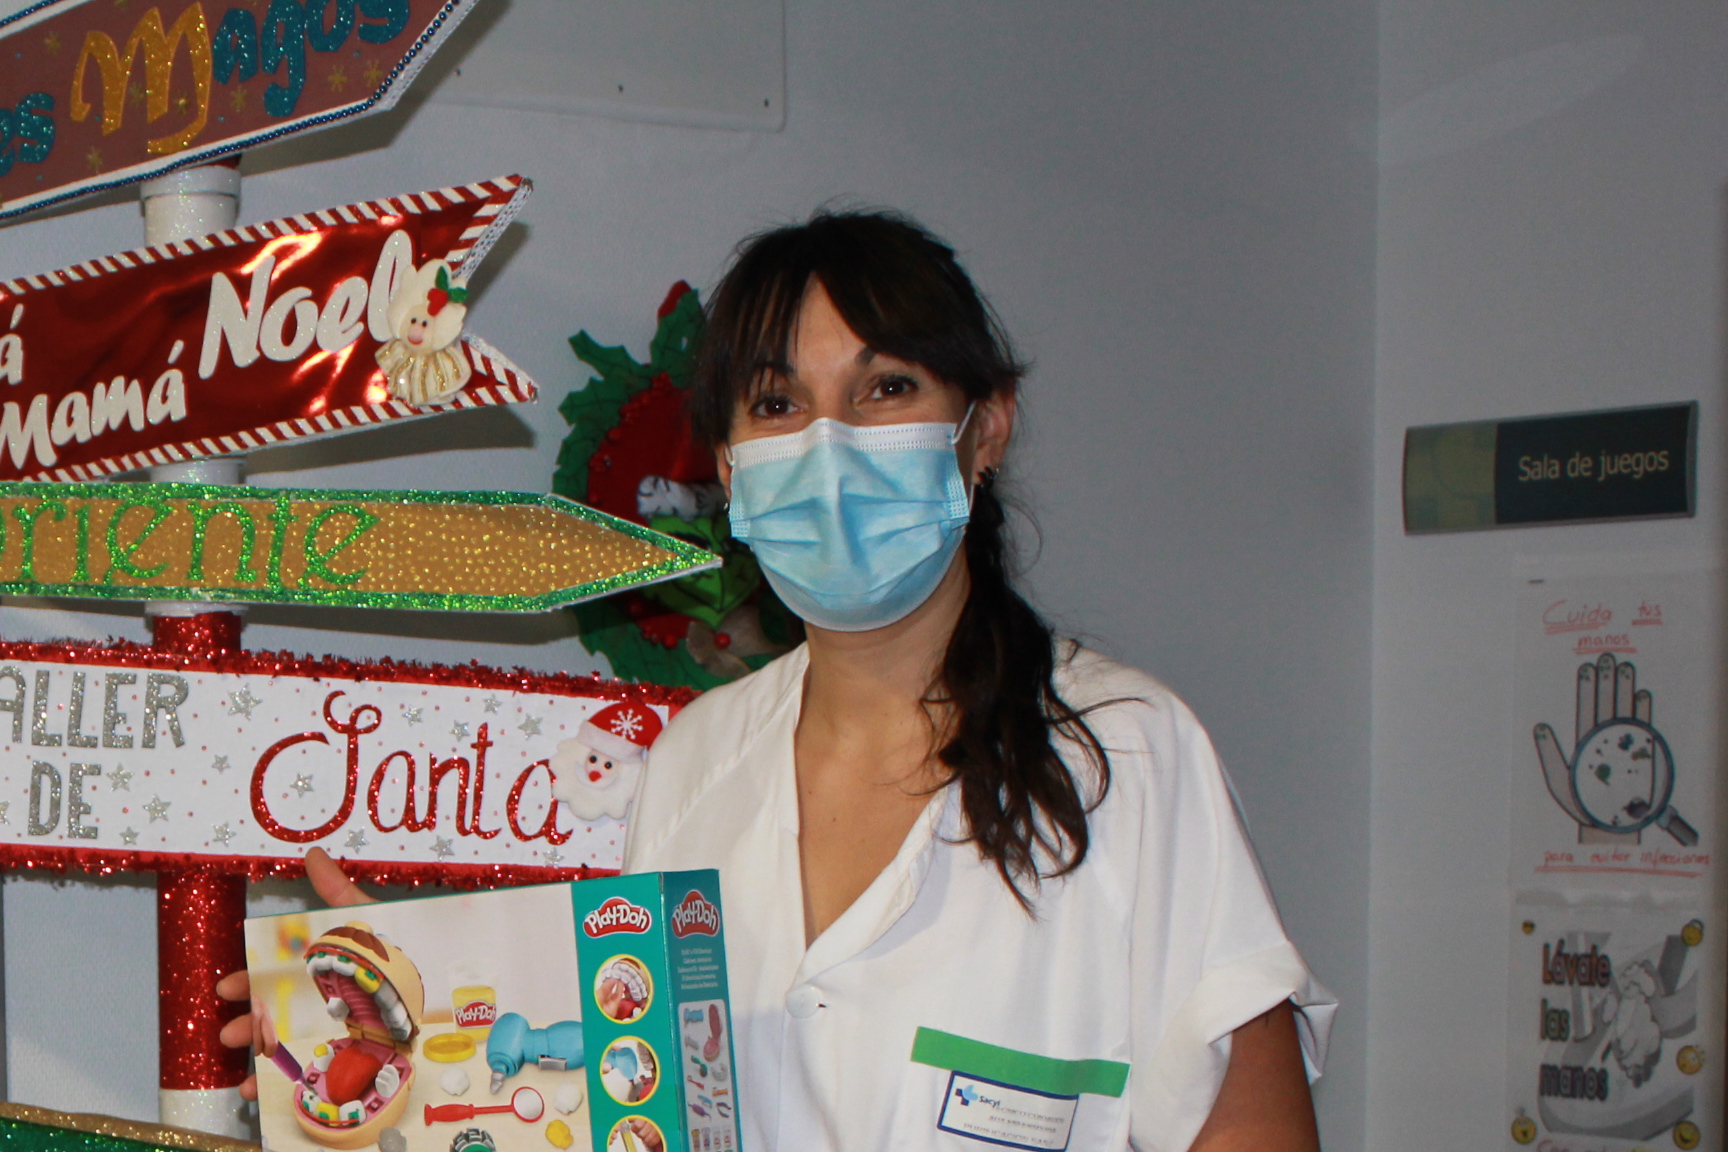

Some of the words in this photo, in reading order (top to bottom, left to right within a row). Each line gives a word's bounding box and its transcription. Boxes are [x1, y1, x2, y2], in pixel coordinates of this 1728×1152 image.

[71, 0, 410, 154] Magos
[198, 229, 415, 380] Noel
[1518, 454, 1560, 481] Sala
[1566, 452, 1592, 478] de
[1597, 449, 1669, 482] juegos
[1542, 601, 1612, 625] Cuida
[1637, 600, 1663, 618] tus
[1578, 632, 1630, 648] manos
[248, 689, 573, 844] Santa
[27, 759, 100, 841] DE
[1541, 938, 1612, 988] Lávate
[1539, 997, 1571, 1042] las
[978, 1094, 1001, 1109] Sacyl
[1539, 1062, 1609, 1101] manos
